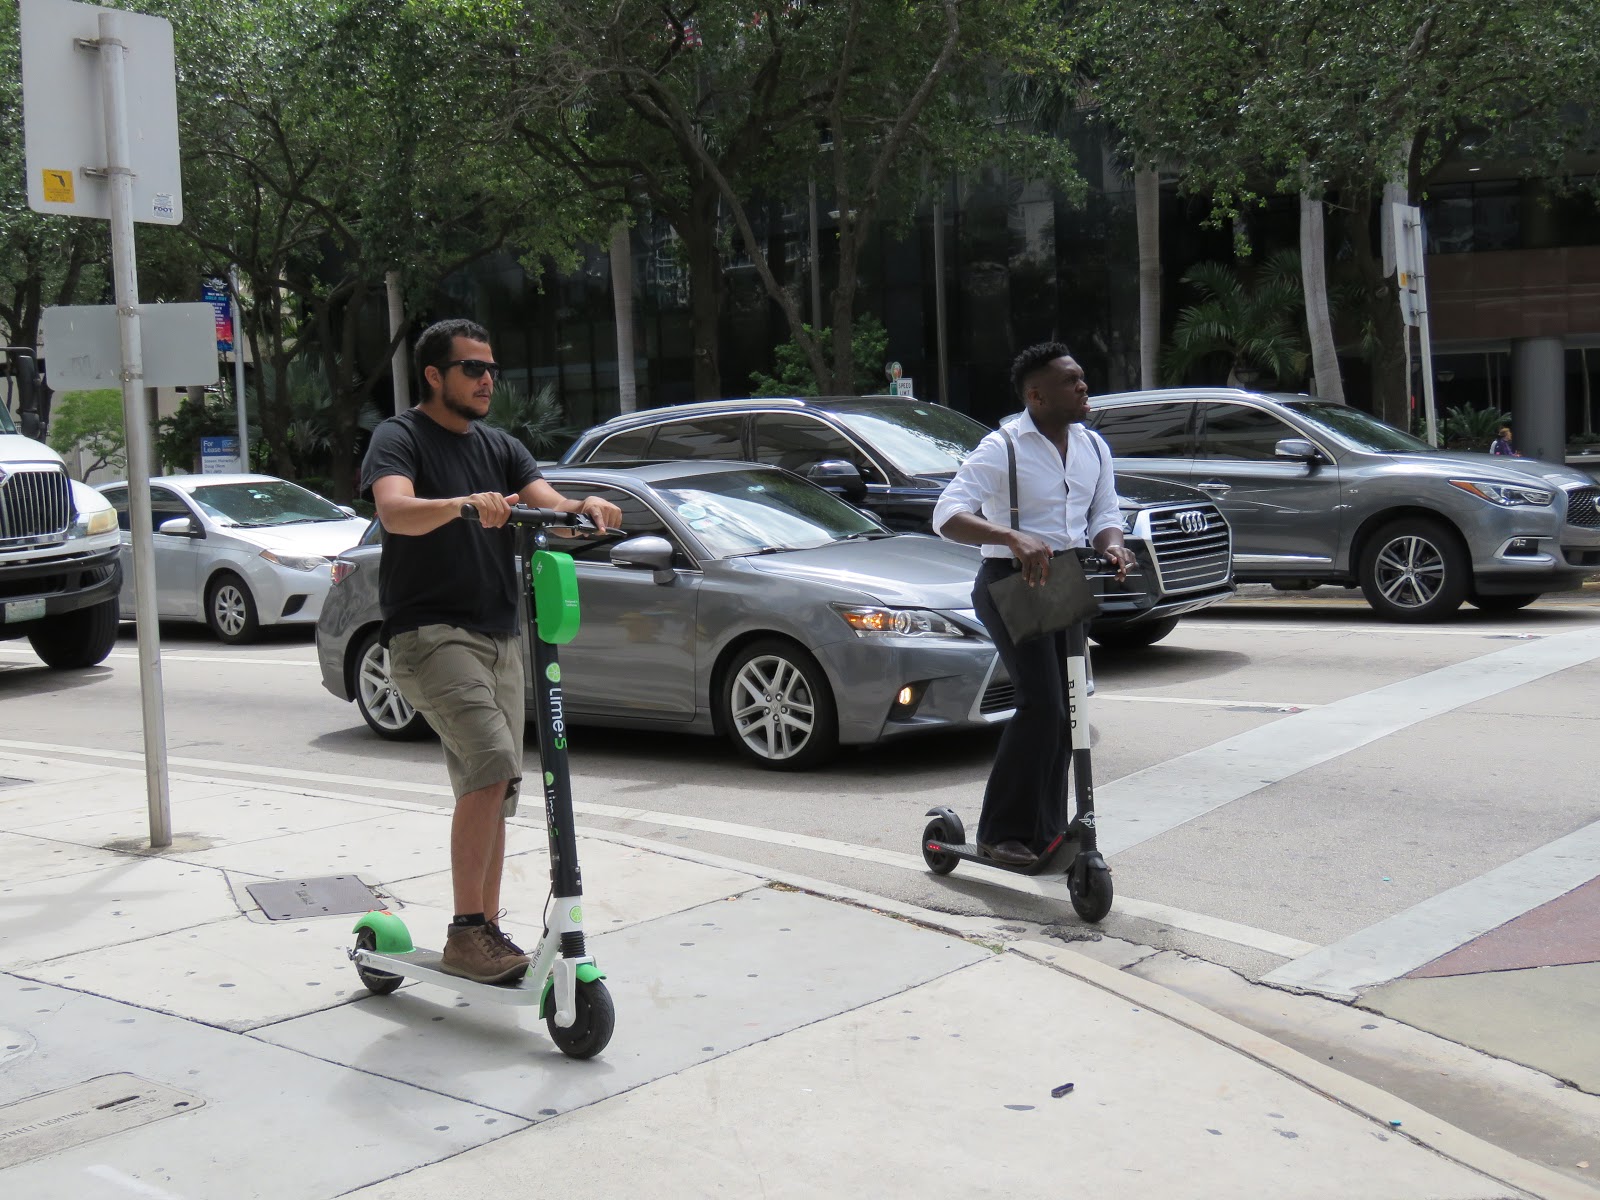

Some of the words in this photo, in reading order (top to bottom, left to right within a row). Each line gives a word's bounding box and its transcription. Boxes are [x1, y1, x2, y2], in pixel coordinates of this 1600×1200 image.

[1068, 680, 1076, 729] BIRD
[0, 1124, 38, 1140] STREET
[37, 1109, 90, 1127] LIGHTING
